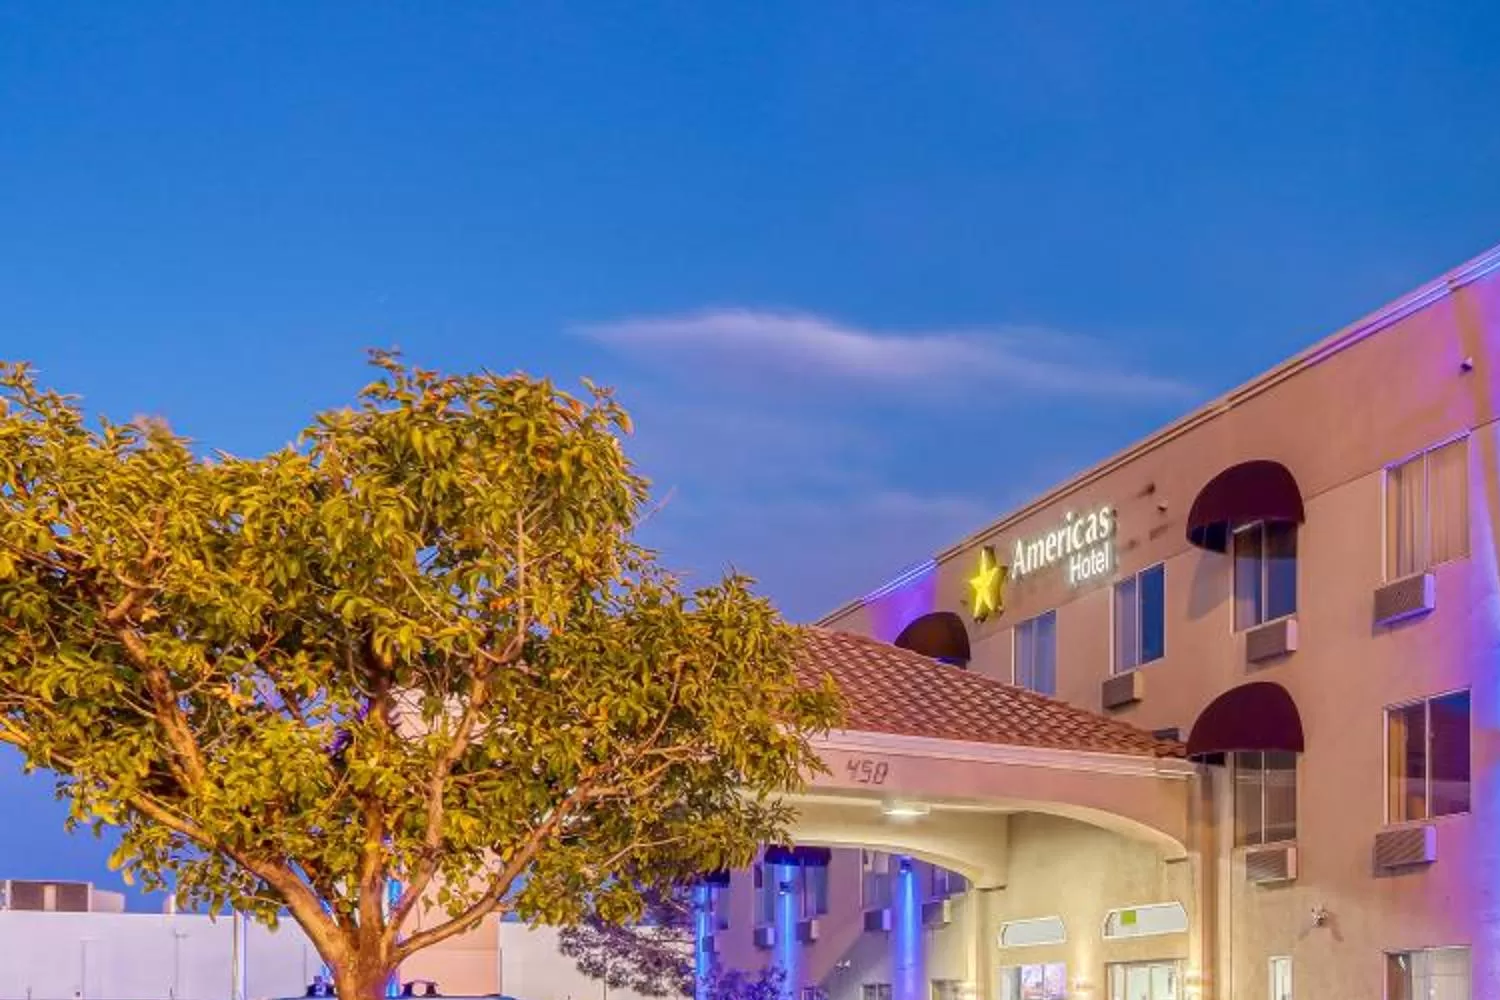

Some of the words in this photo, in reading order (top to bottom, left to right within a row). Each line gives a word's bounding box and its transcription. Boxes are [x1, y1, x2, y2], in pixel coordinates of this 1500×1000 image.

[1011, 505, 1112, 580] Americas
[1069, 541, 1110, 584] Hotel
[846, 759, 889, 785] 450
